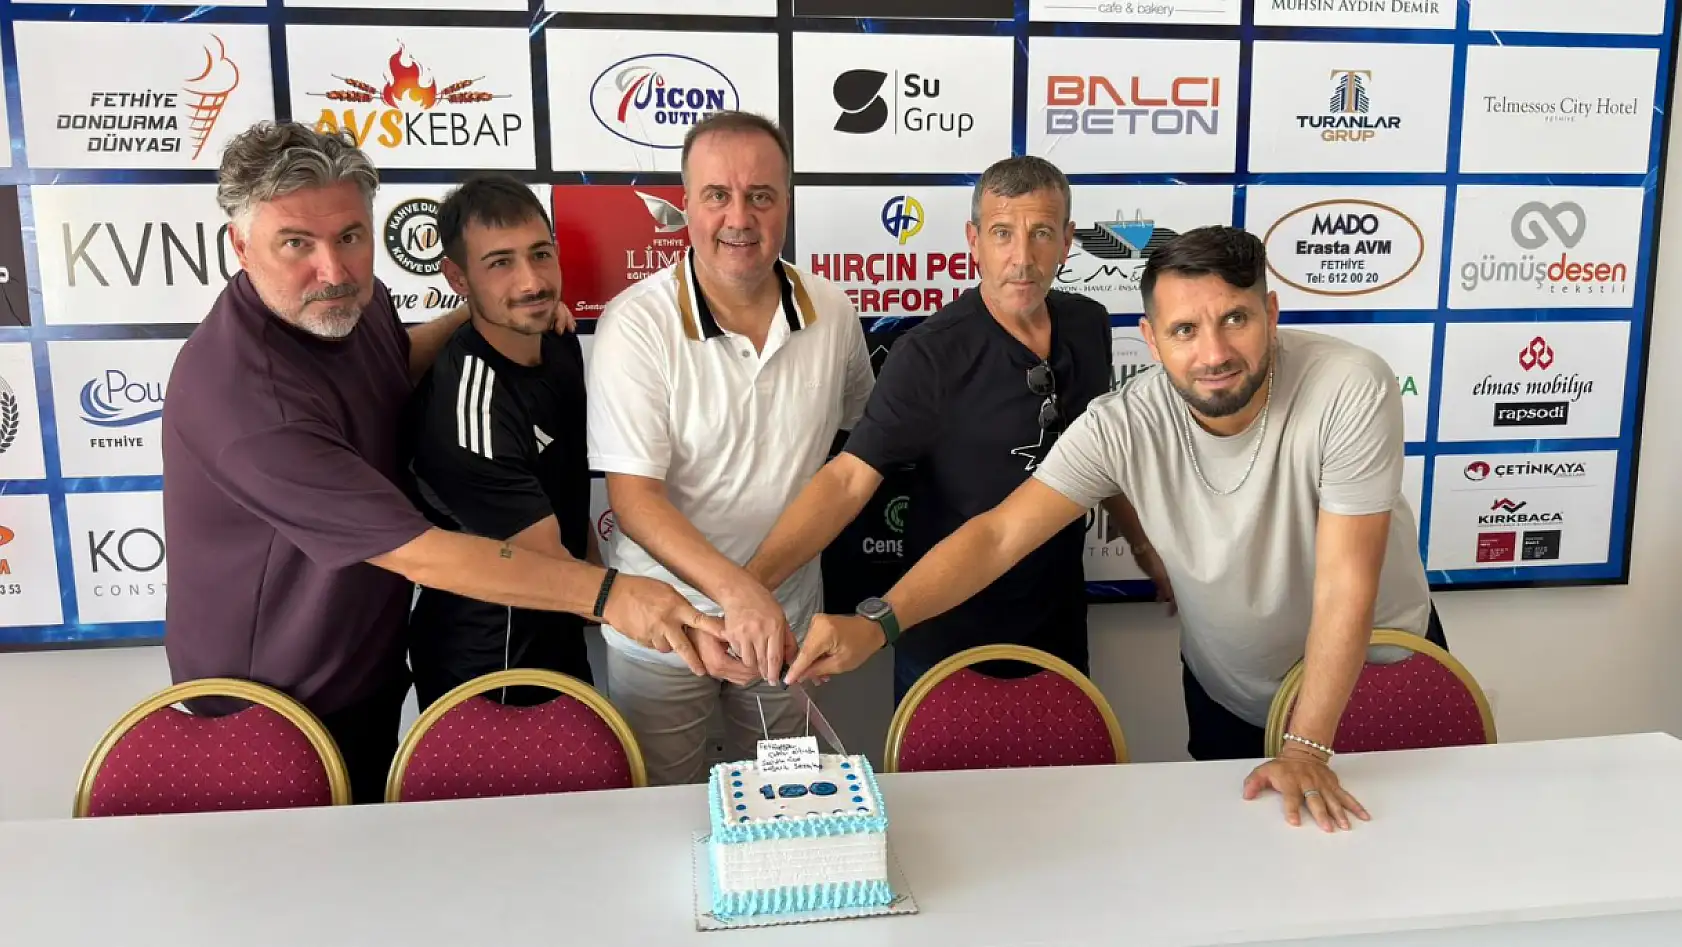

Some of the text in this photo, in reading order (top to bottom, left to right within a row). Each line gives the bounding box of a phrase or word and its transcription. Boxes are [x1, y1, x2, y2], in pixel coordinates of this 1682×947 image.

[1098, 2, 1175, 17] cafe & bakery
[904, 73, 940, 98] Su
[1046, 75, 1220, 107] BALCI
[90, 89, 178, 108] FETHİYE
[1482, 96, 1637, 117] Telmessos City Hotel
[56, 114, 178, 130] DONDURMA
[904, 107, 973, 138] Grup
[1046, 108, 1218, 135] BETON
[1296, 115, 1401, 128] TURANLAR
[87, 133, 181, 152] DÜNYASI
[1320, 130, 1375, 142] GRUP
[390, 202, 439, 229] KAHVE DU
[1311, 213, 1379, 235] MADO
[1296, 240, 1392, 255] Erasta AVM
[392, 246, 441, 273] KAHVE DU
[626, 246, 684, 269] LİM
[1320, 258, 1365, 269] FETHİYE
[811, 253, 917, 285] HIRÇIN
[1306, 272, 1379, 284] Tel: 612 00 20
[1460, 252, 1627, 291] gümüşdesen
[423, 286, 467, 309] Dur
[1550, 284, 1625, 293] tekstil
[1472, 373, 1594, 402] elmas mobilya
[1498, 405, 1566, 421] rapsodi
[89, 435, 144, 448] FETHİYE
[1494, 461, 1586, 479] ÇETİNKAYA
[1478, 512, 1563, 524] KIRKBACA
[88, 527, 166, 573] KO
[1087, 546, 1124, 557] TRU
[9, 583, 22, 595] 53
[93, 584, 167, 597] CONS
